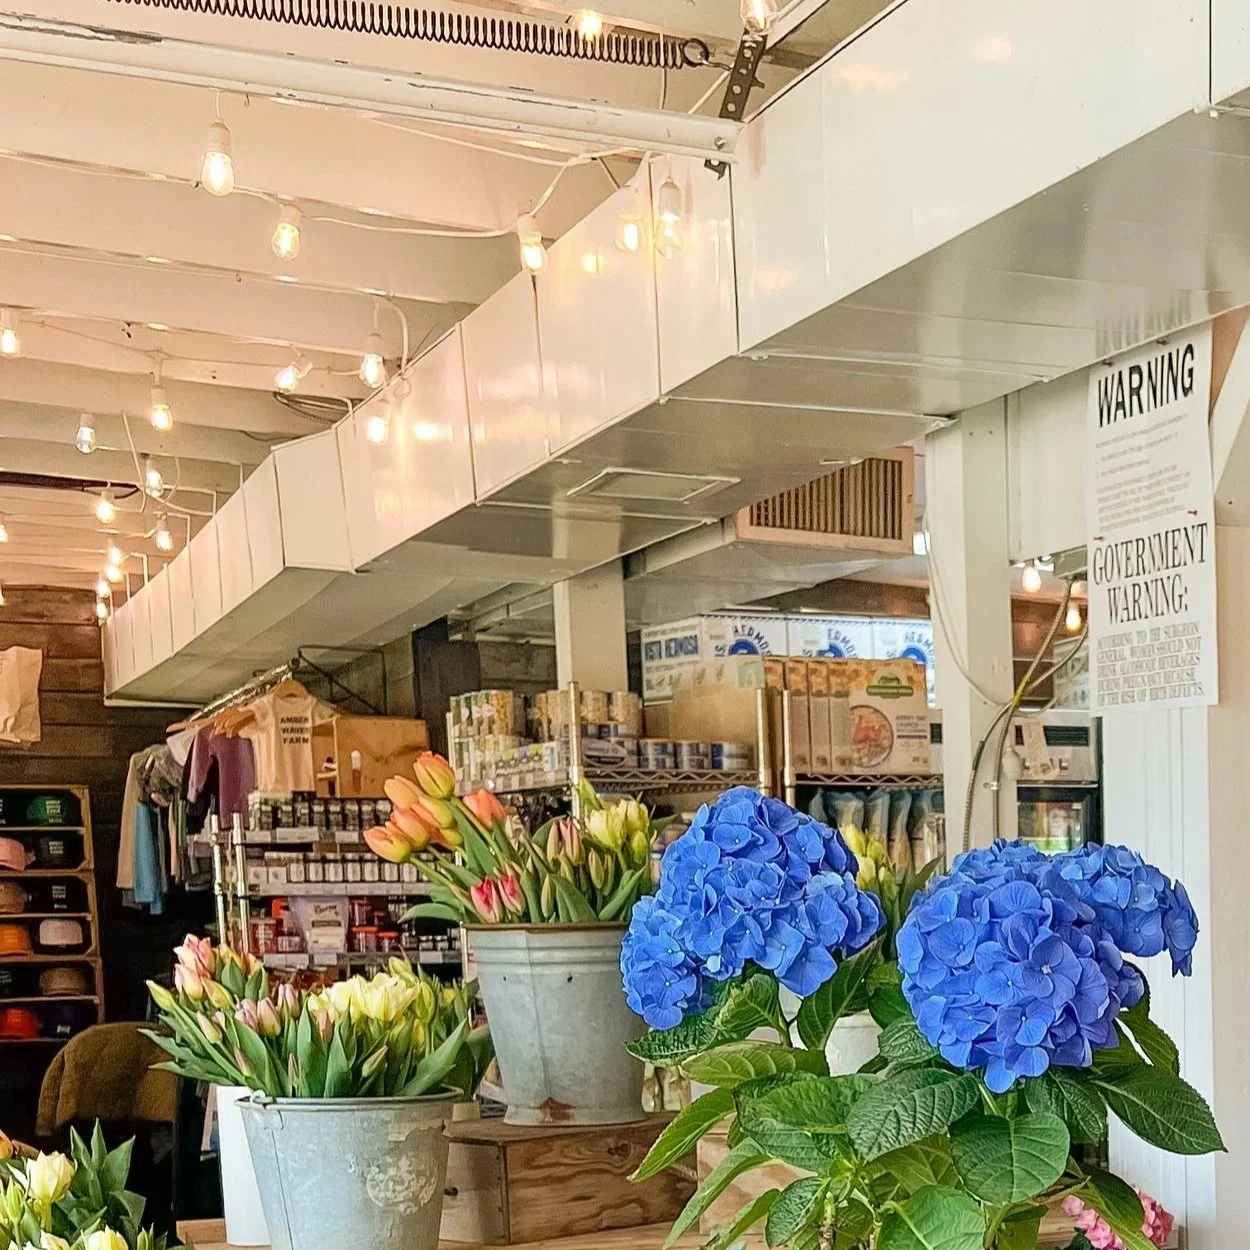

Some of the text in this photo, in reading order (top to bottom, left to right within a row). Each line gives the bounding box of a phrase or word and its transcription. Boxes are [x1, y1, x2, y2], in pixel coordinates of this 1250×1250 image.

[1097, 343, 1194, 428] WARNING
[1093, 523, 1208, 586] GOVERNMENT
[1107, 574, 1188, 625] WARNING:
